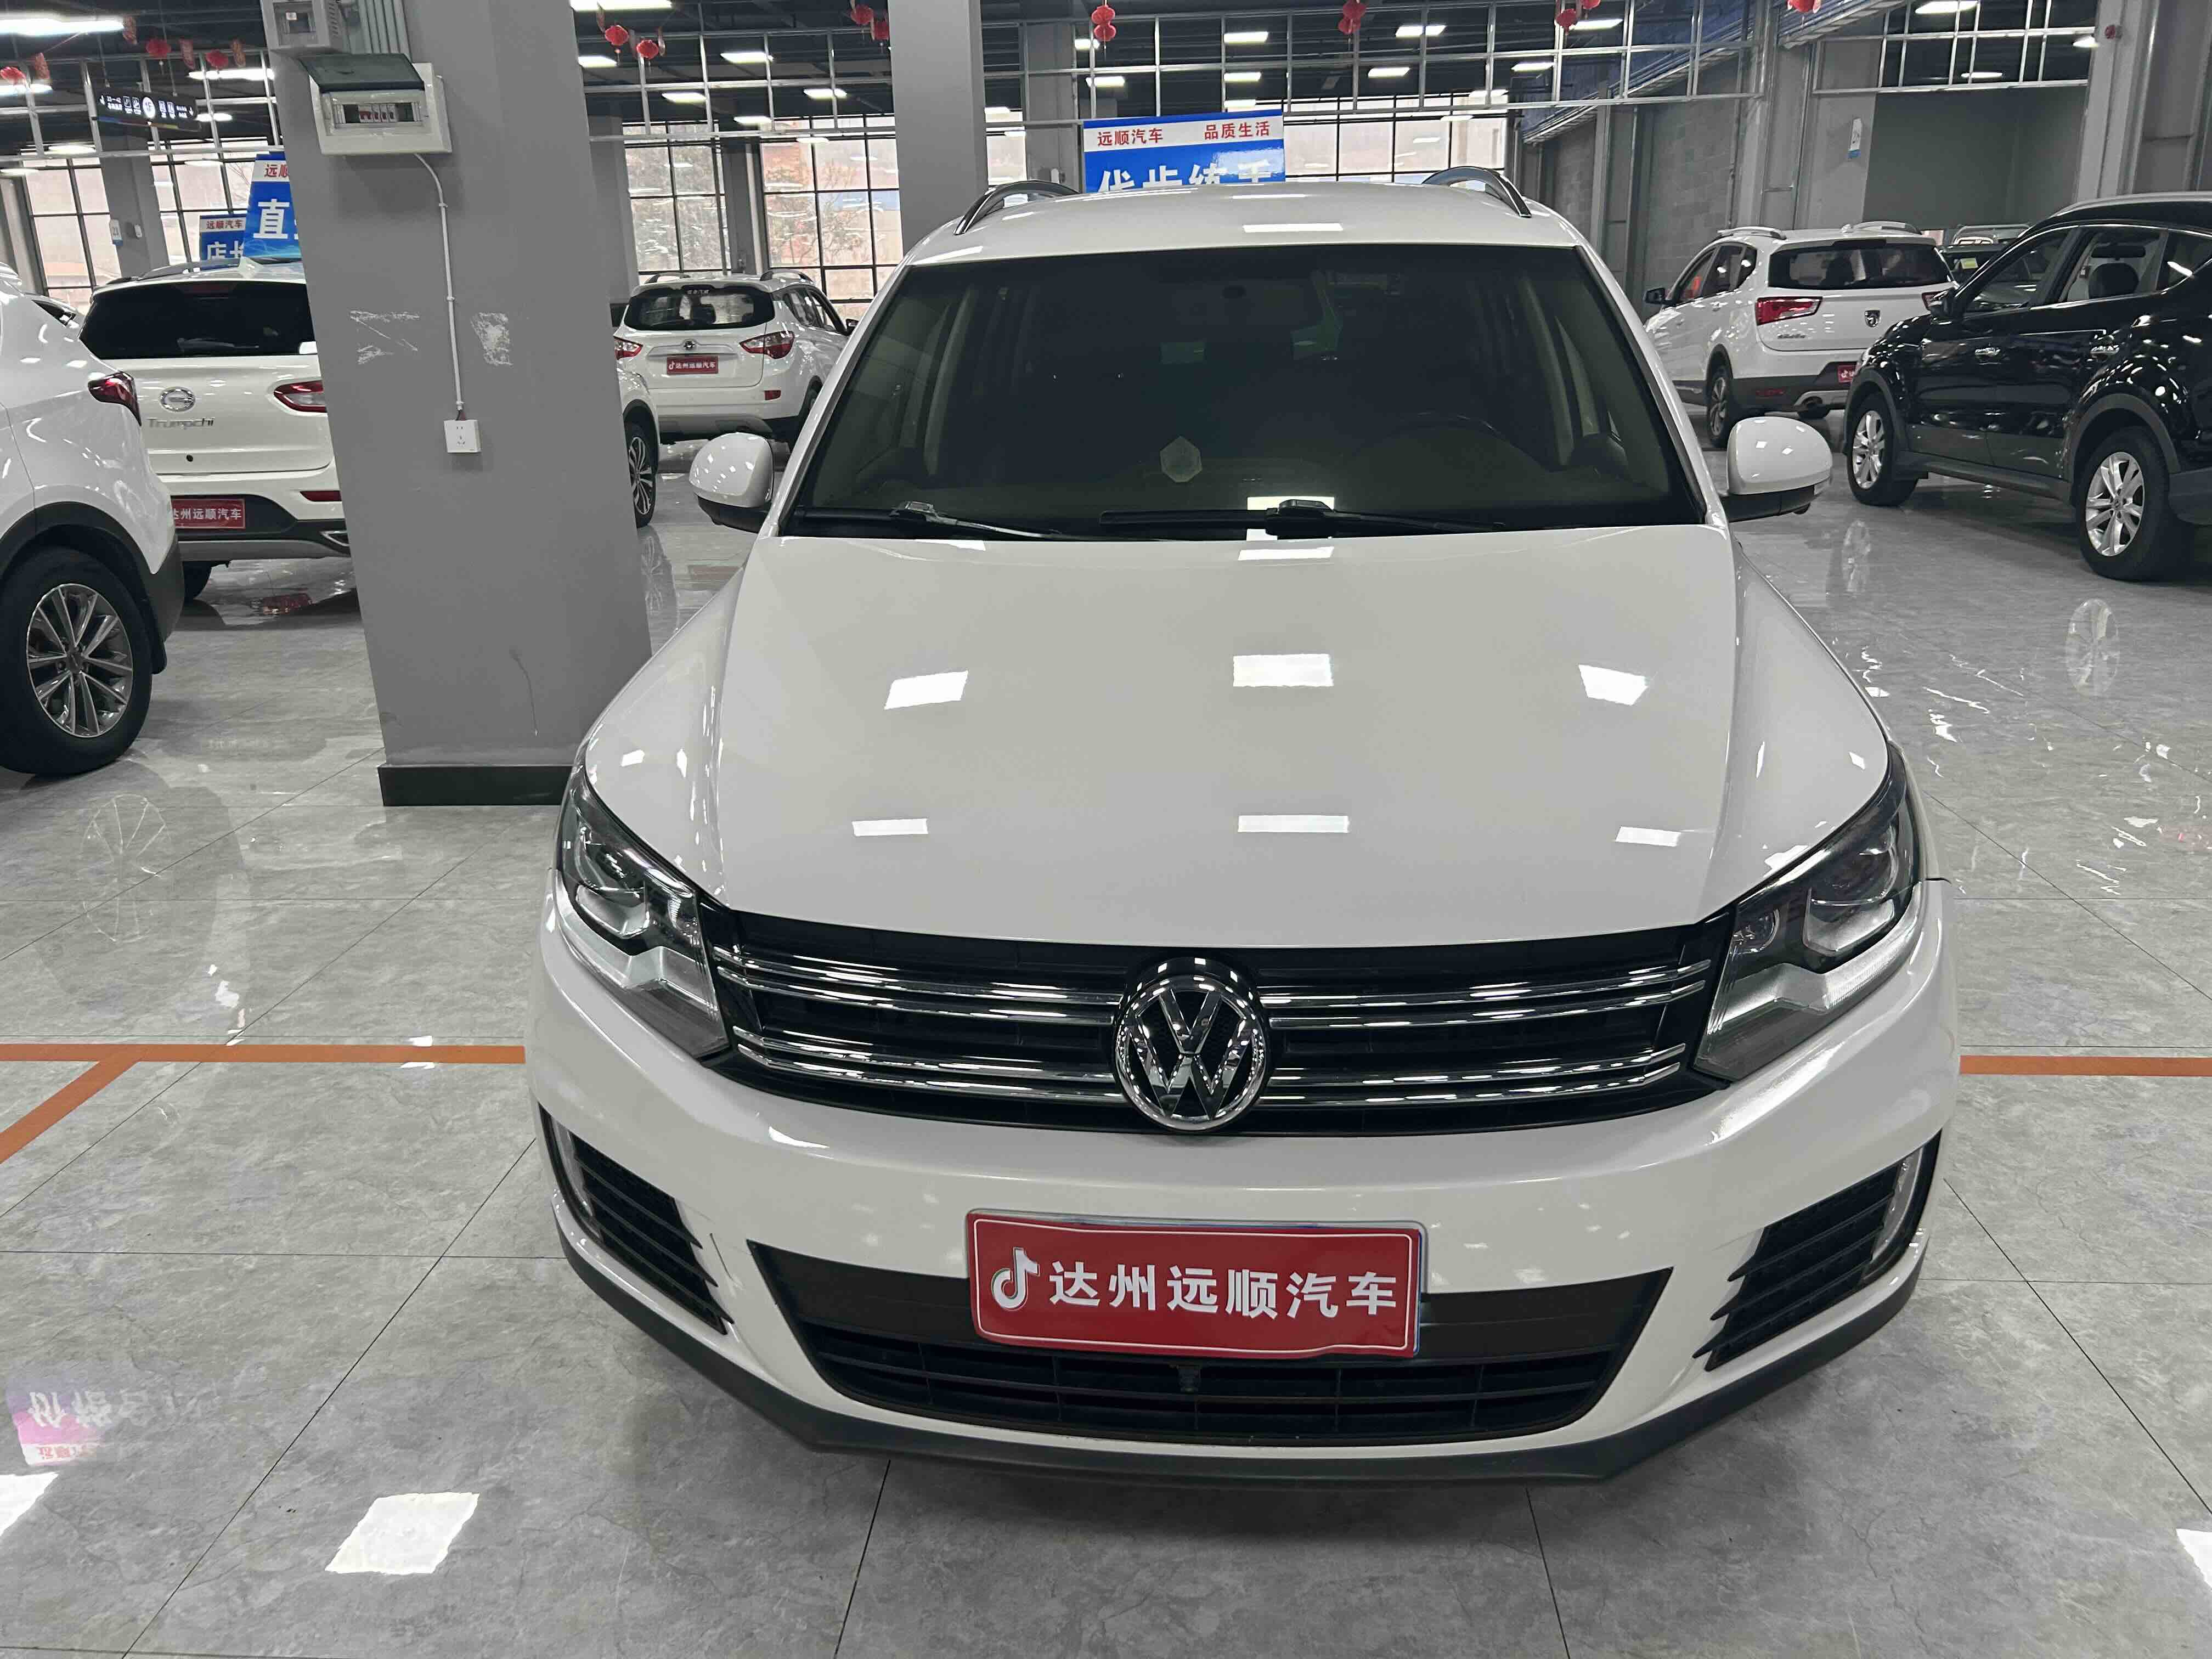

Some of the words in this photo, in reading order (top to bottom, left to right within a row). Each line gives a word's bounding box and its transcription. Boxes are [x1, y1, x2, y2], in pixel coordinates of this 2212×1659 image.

[1098, 128, 1164, 146] 远顺汽车
[1204, 121, 1271, 140] 品质生活
[206, 219, 243, 229] 远顺汽车
[253, 199, 299, 240] 直
[1048, 1261, 1396, 1319] 达州远顺汽车
